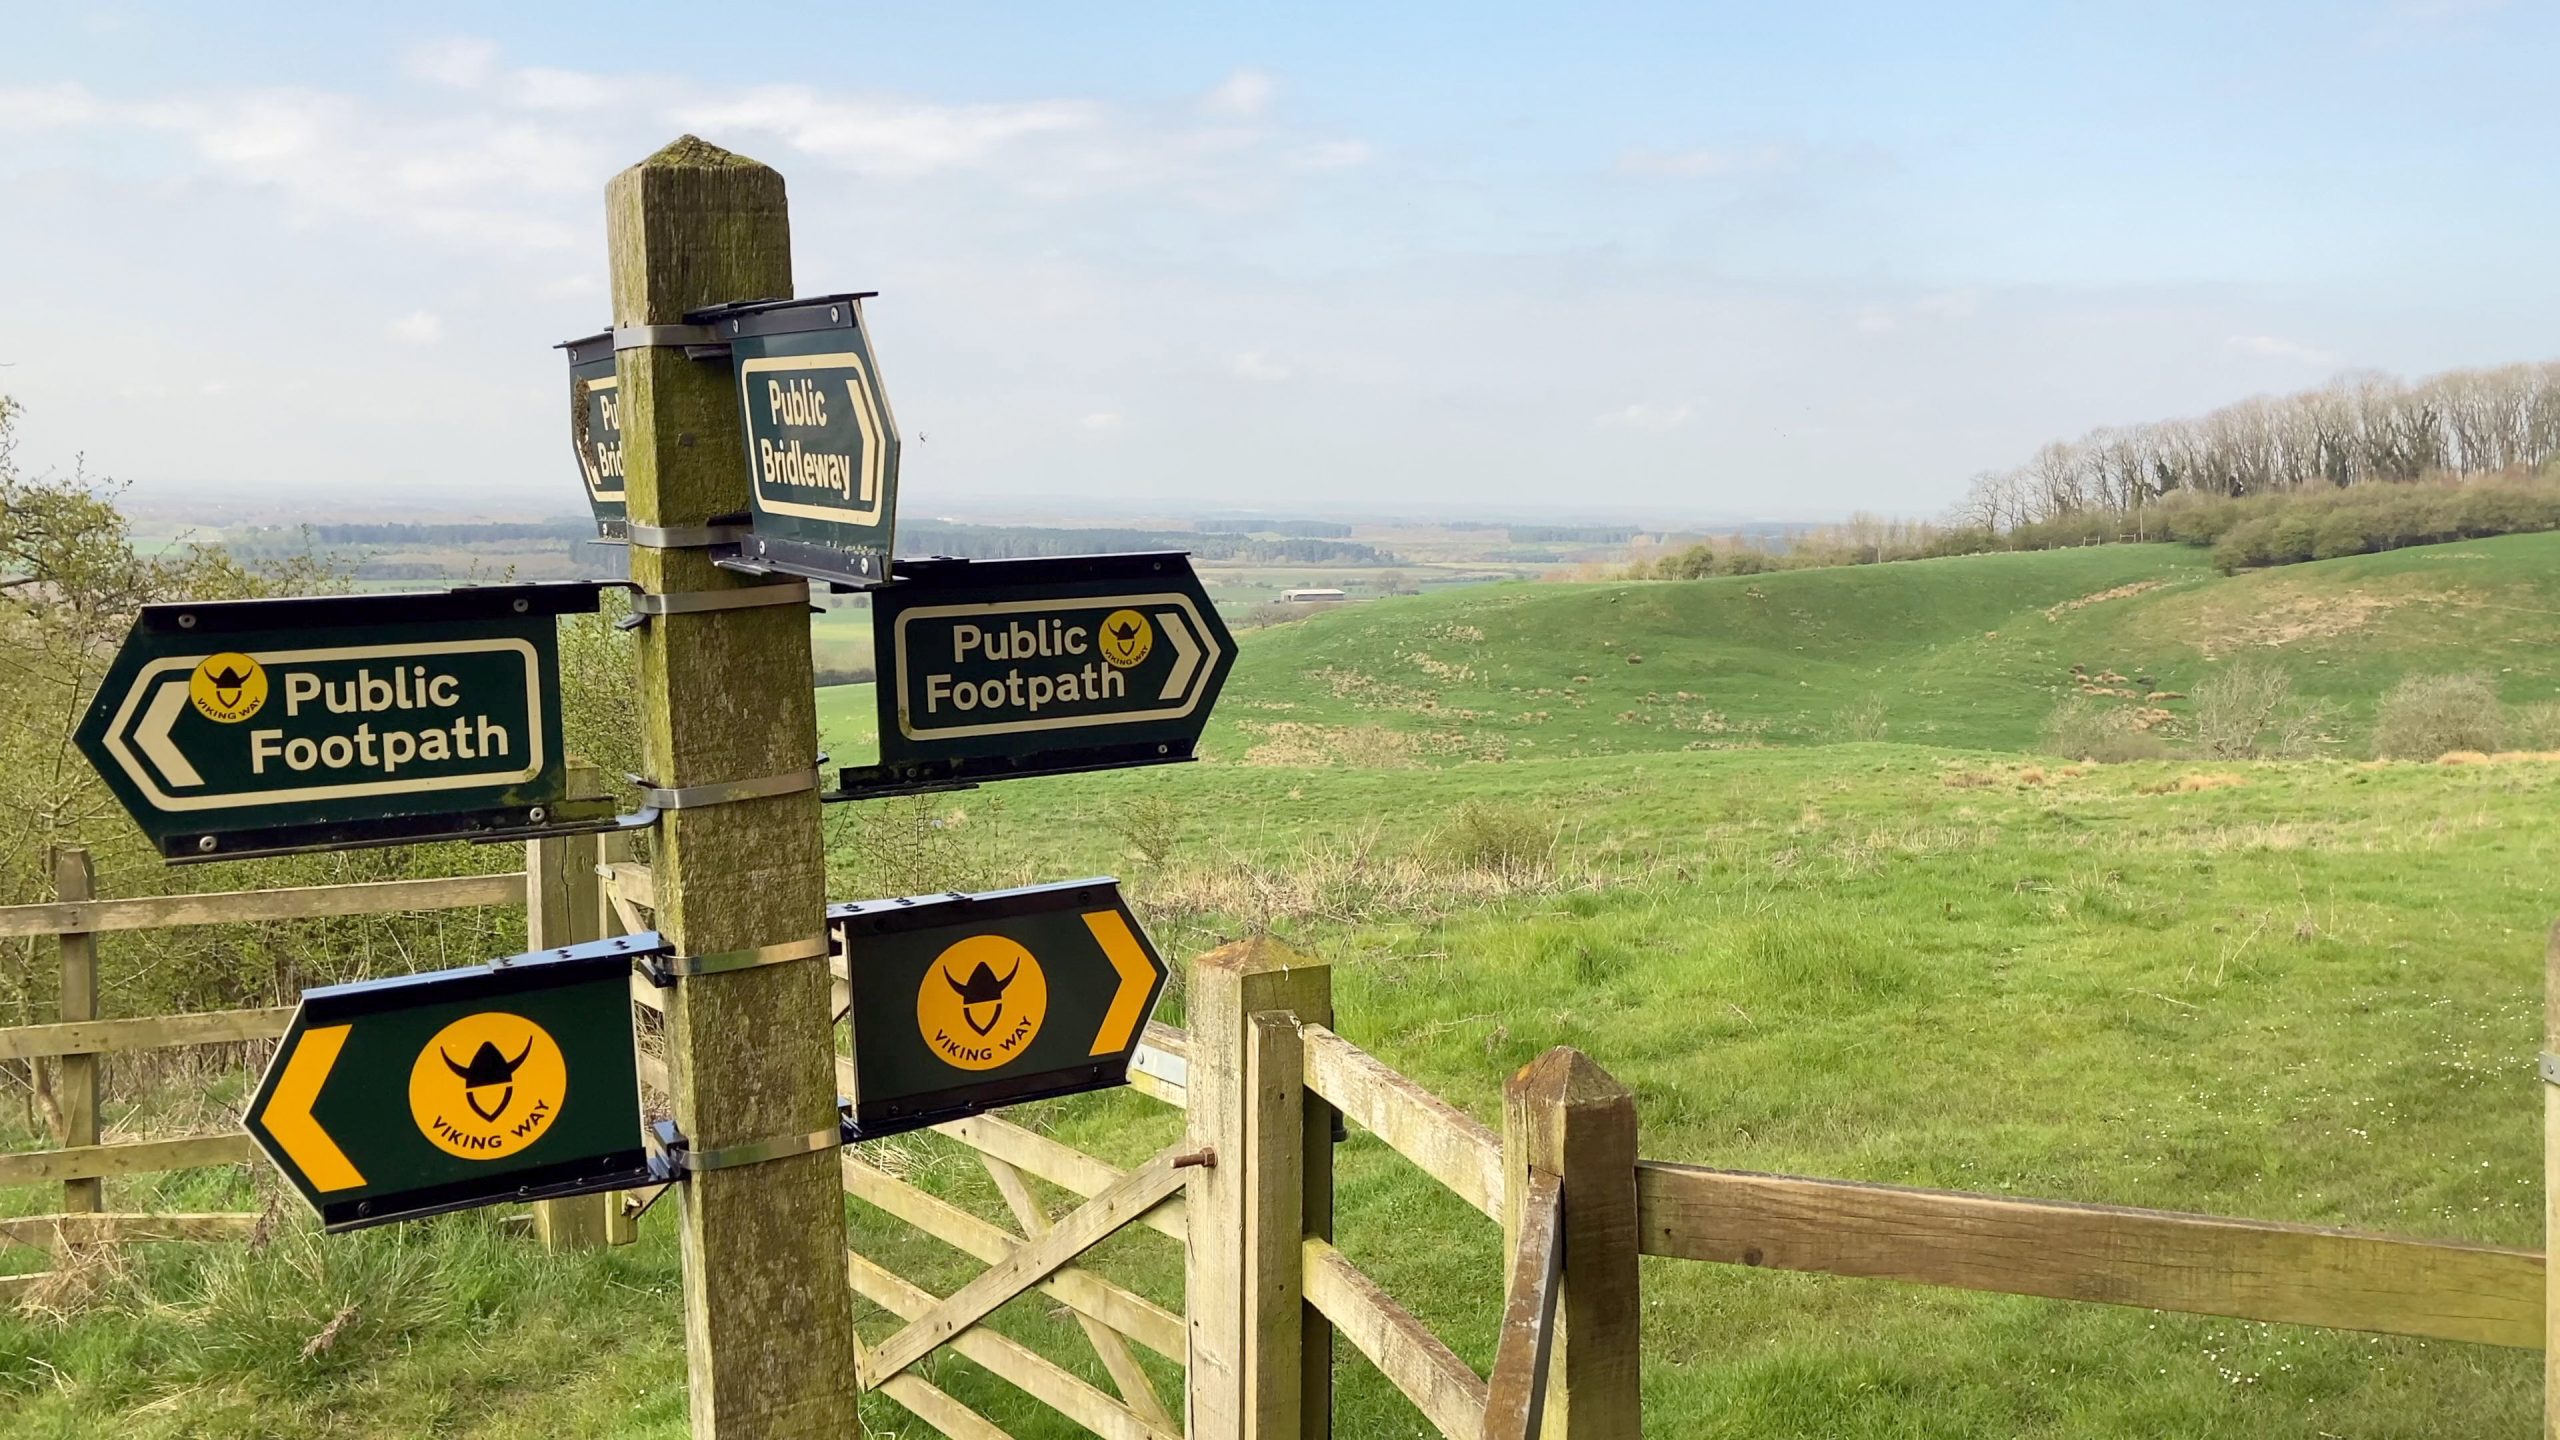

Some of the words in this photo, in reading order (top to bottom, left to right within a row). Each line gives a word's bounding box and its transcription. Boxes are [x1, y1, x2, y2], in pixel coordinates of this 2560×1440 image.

[599, 393, 620, 431] Pu
[768, 378, 827, 427] Public
[760, 438, 850, 500] Bridleway
[953, 618, 1088, 663] Public
[1105, 648, 1132, 665] VIKING
[1134, 645, 1148, 662] WAY
[198, 697, 236, 720] VIKING
[239, 696, 261, 716] WAY
[284, 665, 460, 717] Public
[926, 662, 1126, 713] Footpath
[250, 715, 509, 774] Footpath
[935, 1029, 993, 1061] VIKING
[1000, 1015, 1032, 1051] WAY
[432, 1115, 503, 1150] VIKING
[511, 1099, 549, 1138] WAY
